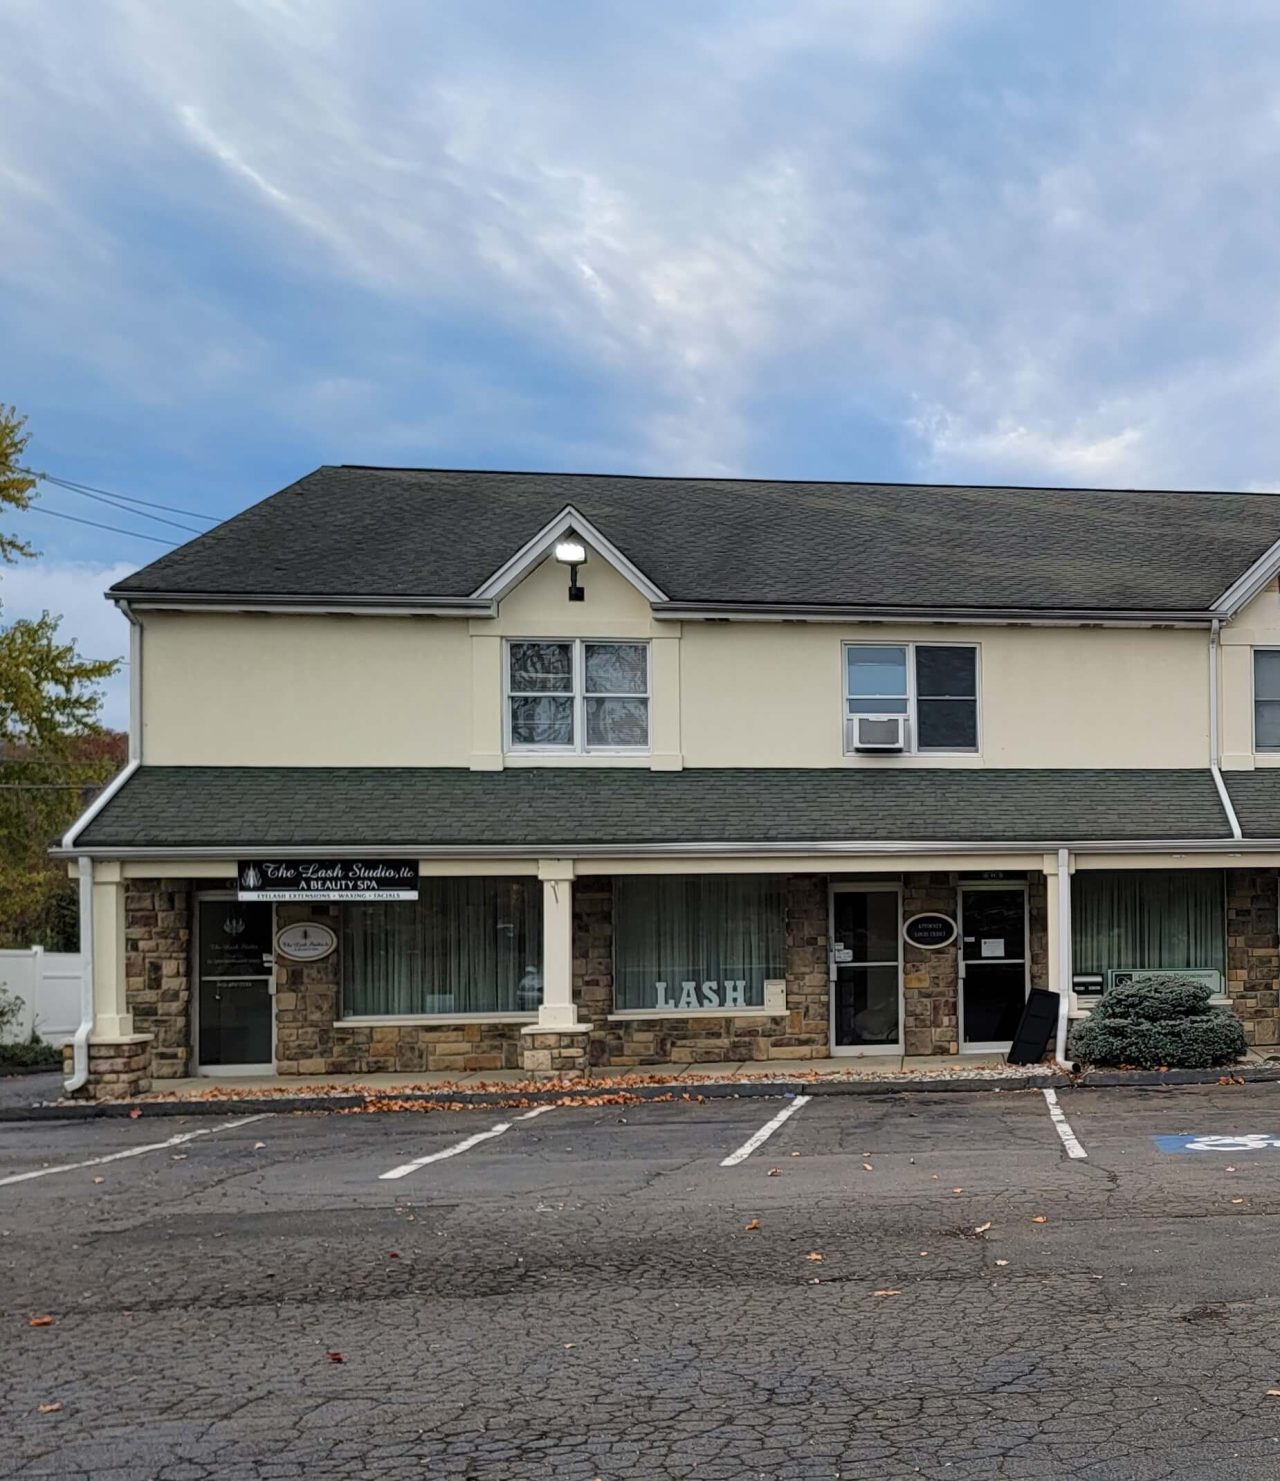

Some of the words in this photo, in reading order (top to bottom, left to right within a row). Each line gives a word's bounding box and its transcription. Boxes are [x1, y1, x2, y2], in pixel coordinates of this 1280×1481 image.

[263, 863, 296, 878] The
[299, 863, 344, 878] Lash
[299, 880, 308, 890] A
[310, 880, 354, 890] BEAUTY
[357, 880, 379, 889] SPA
[655, 980, 747, 1009] LASH
